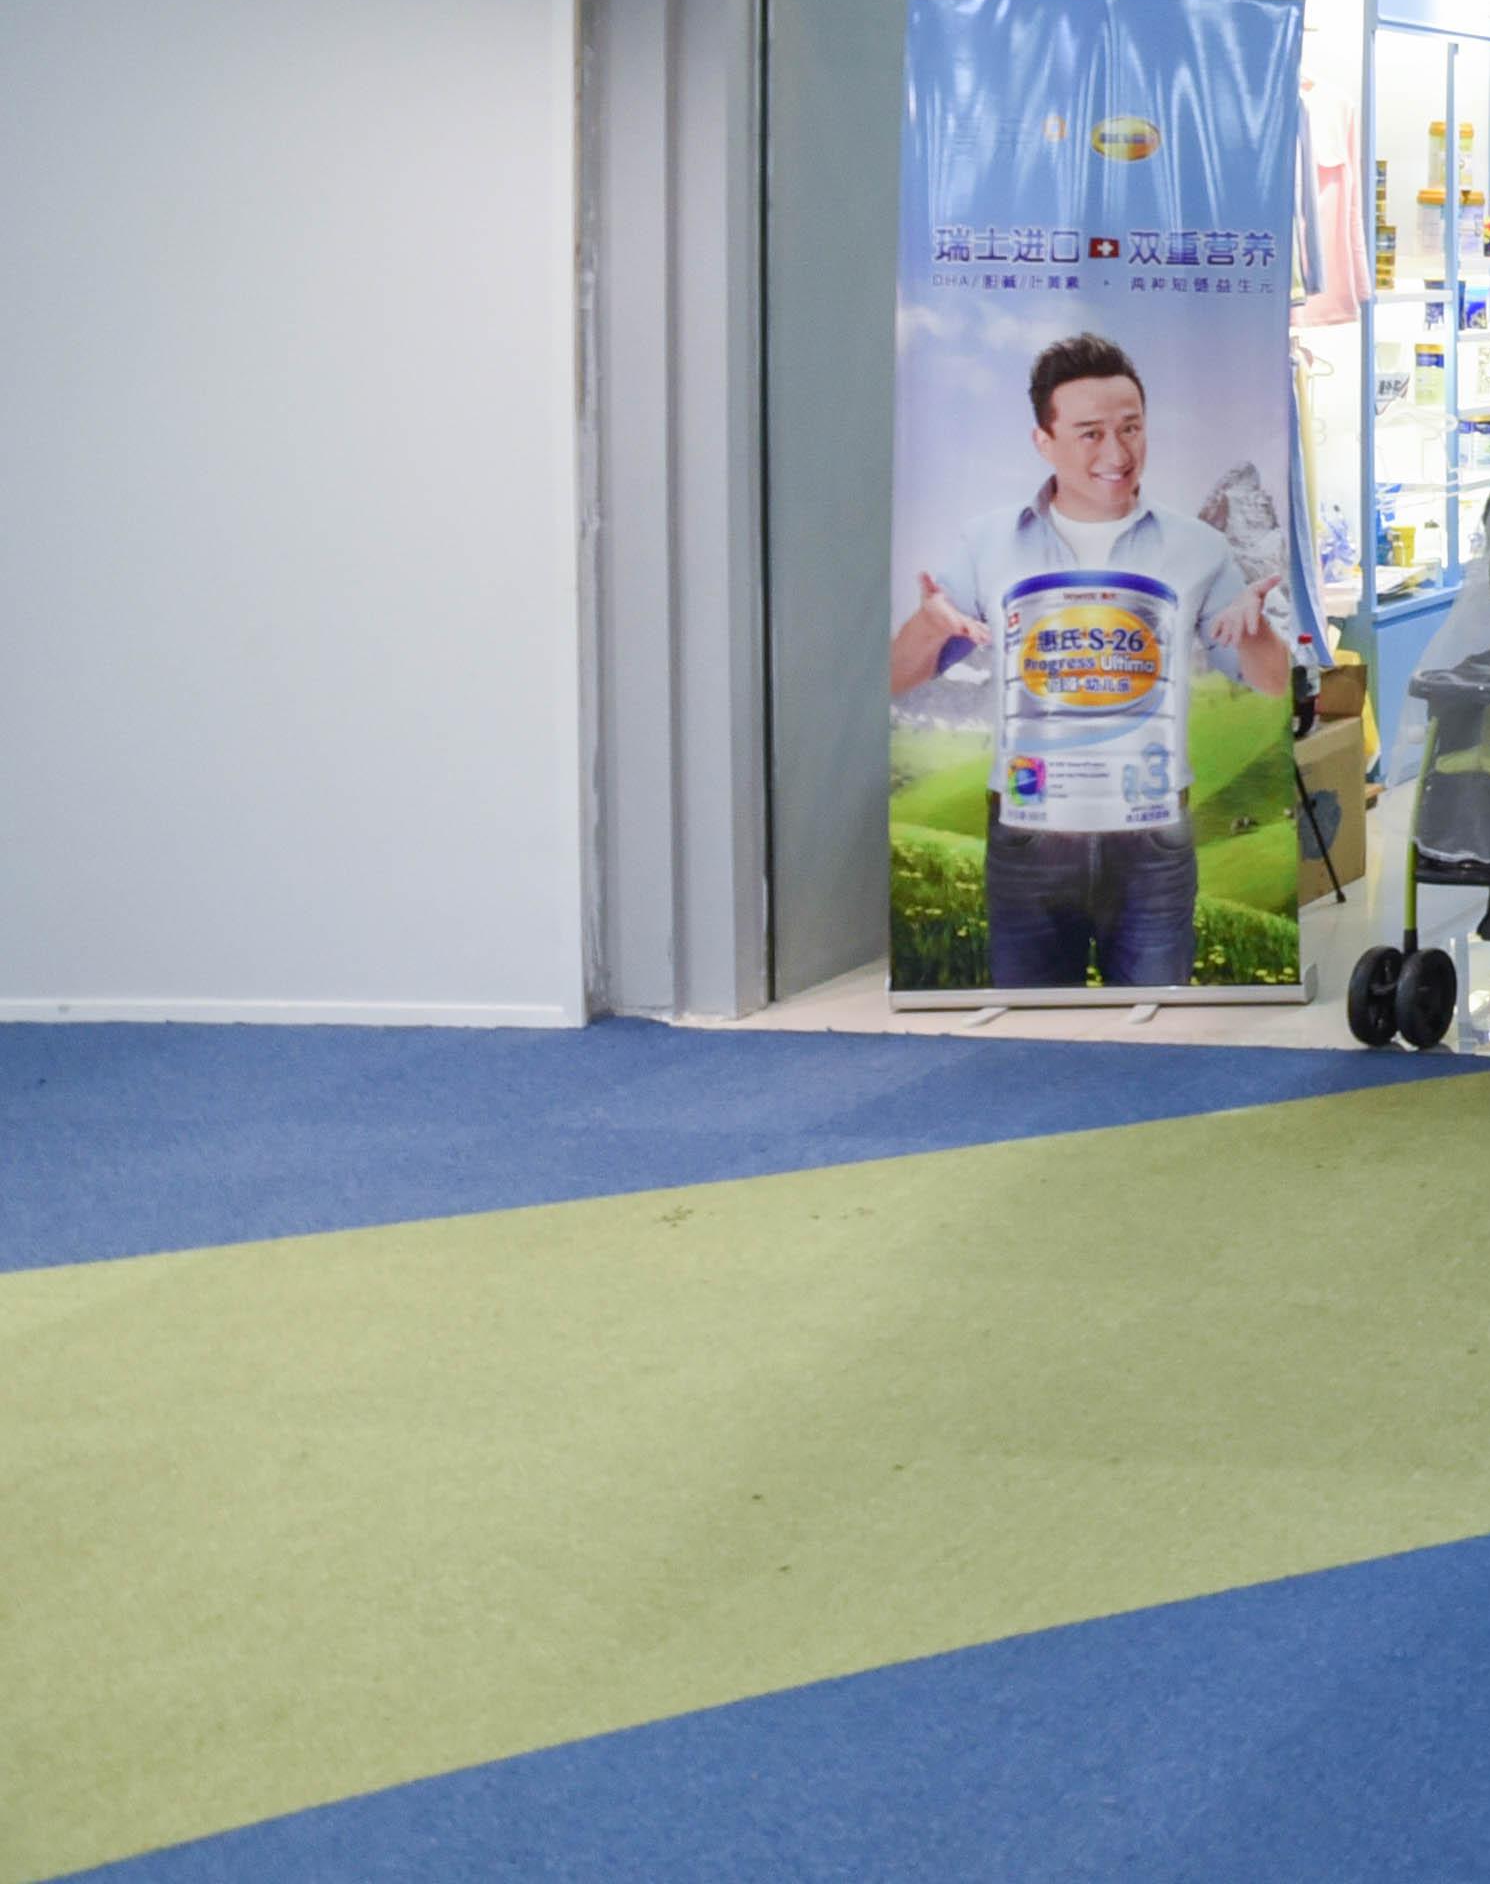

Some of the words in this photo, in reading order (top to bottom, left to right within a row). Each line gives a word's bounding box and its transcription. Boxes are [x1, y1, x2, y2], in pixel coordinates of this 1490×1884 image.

[934, 227, 1080, 264] 瑞士进口
[1128, 230, 1276, 267] 双重营养
[1088, 627, 1145, 653] S-26
[1024, 656, 1096, 678] Progress
